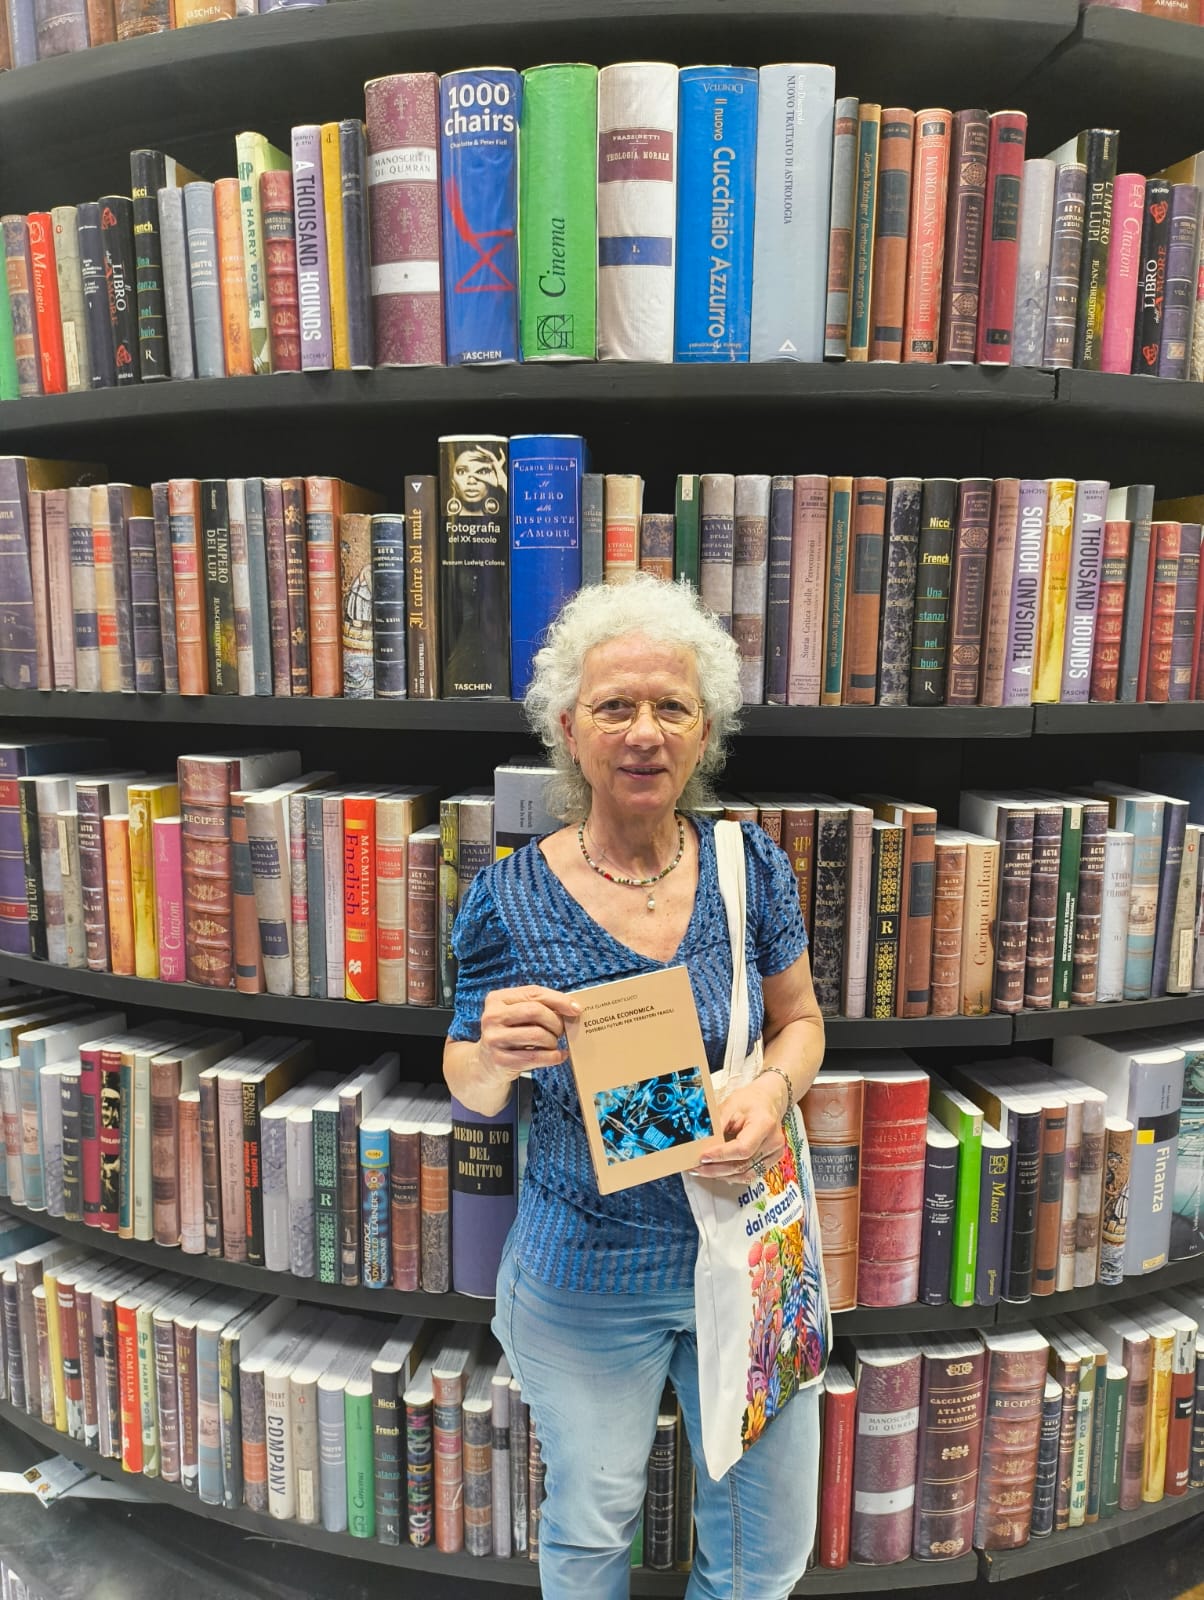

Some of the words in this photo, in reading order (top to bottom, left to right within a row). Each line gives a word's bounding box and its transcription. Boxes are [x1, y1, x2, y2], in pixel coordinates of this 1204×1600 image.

[448, 83, 510, 109] 1000
[786, 75, 796, 108] NUOVO
[444, 109, 515, 137] chairs
[713, 108, 724, 141] nuovo
[784, 110, 795, 156] TRATTATO
[295, 160, 315, 172] A
[784, 157, 794, 167] DI
[711, 146, 736, 250] Cucchiaio
[783, 169, 793, 225] ASTROLOGIA
[924, 154, 938, 235] SANCTORUM
[1092, 183, 1104, 206] DEI
[296, 174, 318, 267] THOUSAND
[1088, 211, 1102, 242] LUPI
[1100, 181, 1113, 245] L'IMPERO
[246, 208, 257, 257] HARRY
[538, 217, 566, 297] Cinema
[1119, 217, 1141, 279] Citazioni
[33, 252, 45, 313] Mitologia
[112, 263, 127, 311] LIBRO
[250, 264, 261, 319] POTTER
[919, 237, 934, 323] BIBLIOTHECA
[1087, 259, 1100, 327] JEAN-CHRISTOPHE
[1144, 259, 1158, 309] LIBRO
[300, 271, 322, 341] HOUNDS
[707, 255, 732, 339] Azzurro
[145, 350, 157, 363] R
[462, 350, 502, 360] TASCHEN
[524, 491, 564, 500] LIBRO
[410, 508, 423, 540] male
[446, 521, 501, 536] Fotografia
[515, 515, 576, 525] RISPOSTE
[930, 517, 951, 528] Nicci
[1082, 512, 1102, 523] A
[207, 530, 217, 550] DEI
[409, 545, 423, 564] del
[472, 536, 497, 544] secolo
[1019, 506, 1044, 574] HOUNDS
[207, 554, 217, 582] LUPI
[216, 527, 229, 584] L'IMPERO
[464, 559, 484, 567] Ludwig
[923, 552, 950, 564] French
[1075, 527, 1101, 611] THOUSAND
[410, 567, 423, 608] colore
[926, 587, 943, 597] Una
[409, 611, 428, 630] Il
[919, 611, 945, 621] stanza
[1013, 577, 1038, 662] THOUSAND
[775, 646, 781, 656] 2
[924, 638, 938, 648] nel
[1068, 615, 1094, 679] HOUNDS
[920, 659, 938, 668] buio
[1011, 665, 1031, 676] A
[454, 683, 492, 691] TASCHEN
[924, 681, 936, 694] R
[184, 814, 225, 826] RECIPES
[346, 833, 361, 916] English
[360, 835, 370, 916] MACMILLAN
[977, 851, 993, 909] italiana
[28, 878, 37, 901] LUPI
[30, 904, 39, 921] DEI
[164, 901, 181, 950] Citazioni
[880, 920, 893, 934] R
[974, 914, 989, 966] Cucina
[583, 1015, 616, 1028] ECOLOGIA
[616, 1005, 655, 1020] ECONOMICA
[606, 1021, 624, 1029] FUTURI
[633, 1012, 657, 1022] TERRITORI
[250, 1141, 258, 1156] UN
[453, 1126, 484, 1143] MEDIO
[489, 1130, 509, 1144] EVO
[469, 1147, 490, 1161] DEL
[250, 1158, 259, 1188] DRINK
[458, 1164, 503, 1178] DIRITTO
[1152, 1146, 1170, 1213] Finanza
[320, 1195, 332, 1205] R
[371, 1190, 379, 1235] LEARNER'S
[989, 1182, 1006, 1223] Musica
[745, 1213, 763, 1236] dai
[363, 1222, 372, 1282] CAMBRIDGE
[371, 1238, 379, 1282] ADVANCED
[125, 1336, 135, 1402] MACMILLAN
[183, 1378, 191, 1412] HARRY
[377, 1399, 396, 1409] Nicci
[930, 1392, 981, 1405] CACCIATORE
[995, 1398, 1042, 1409] RECIPES
[375, 1425, 400, 1436] French
[937, 1413, 977, 1425] ISTORICO
[185, 1416, 193, 1455] POTTER
[267, 1416, 285, 1495] COMPANY
[1076, 1442, 1085, 1477] HARRY
[353, 1471, 365, 1508] Cinema
